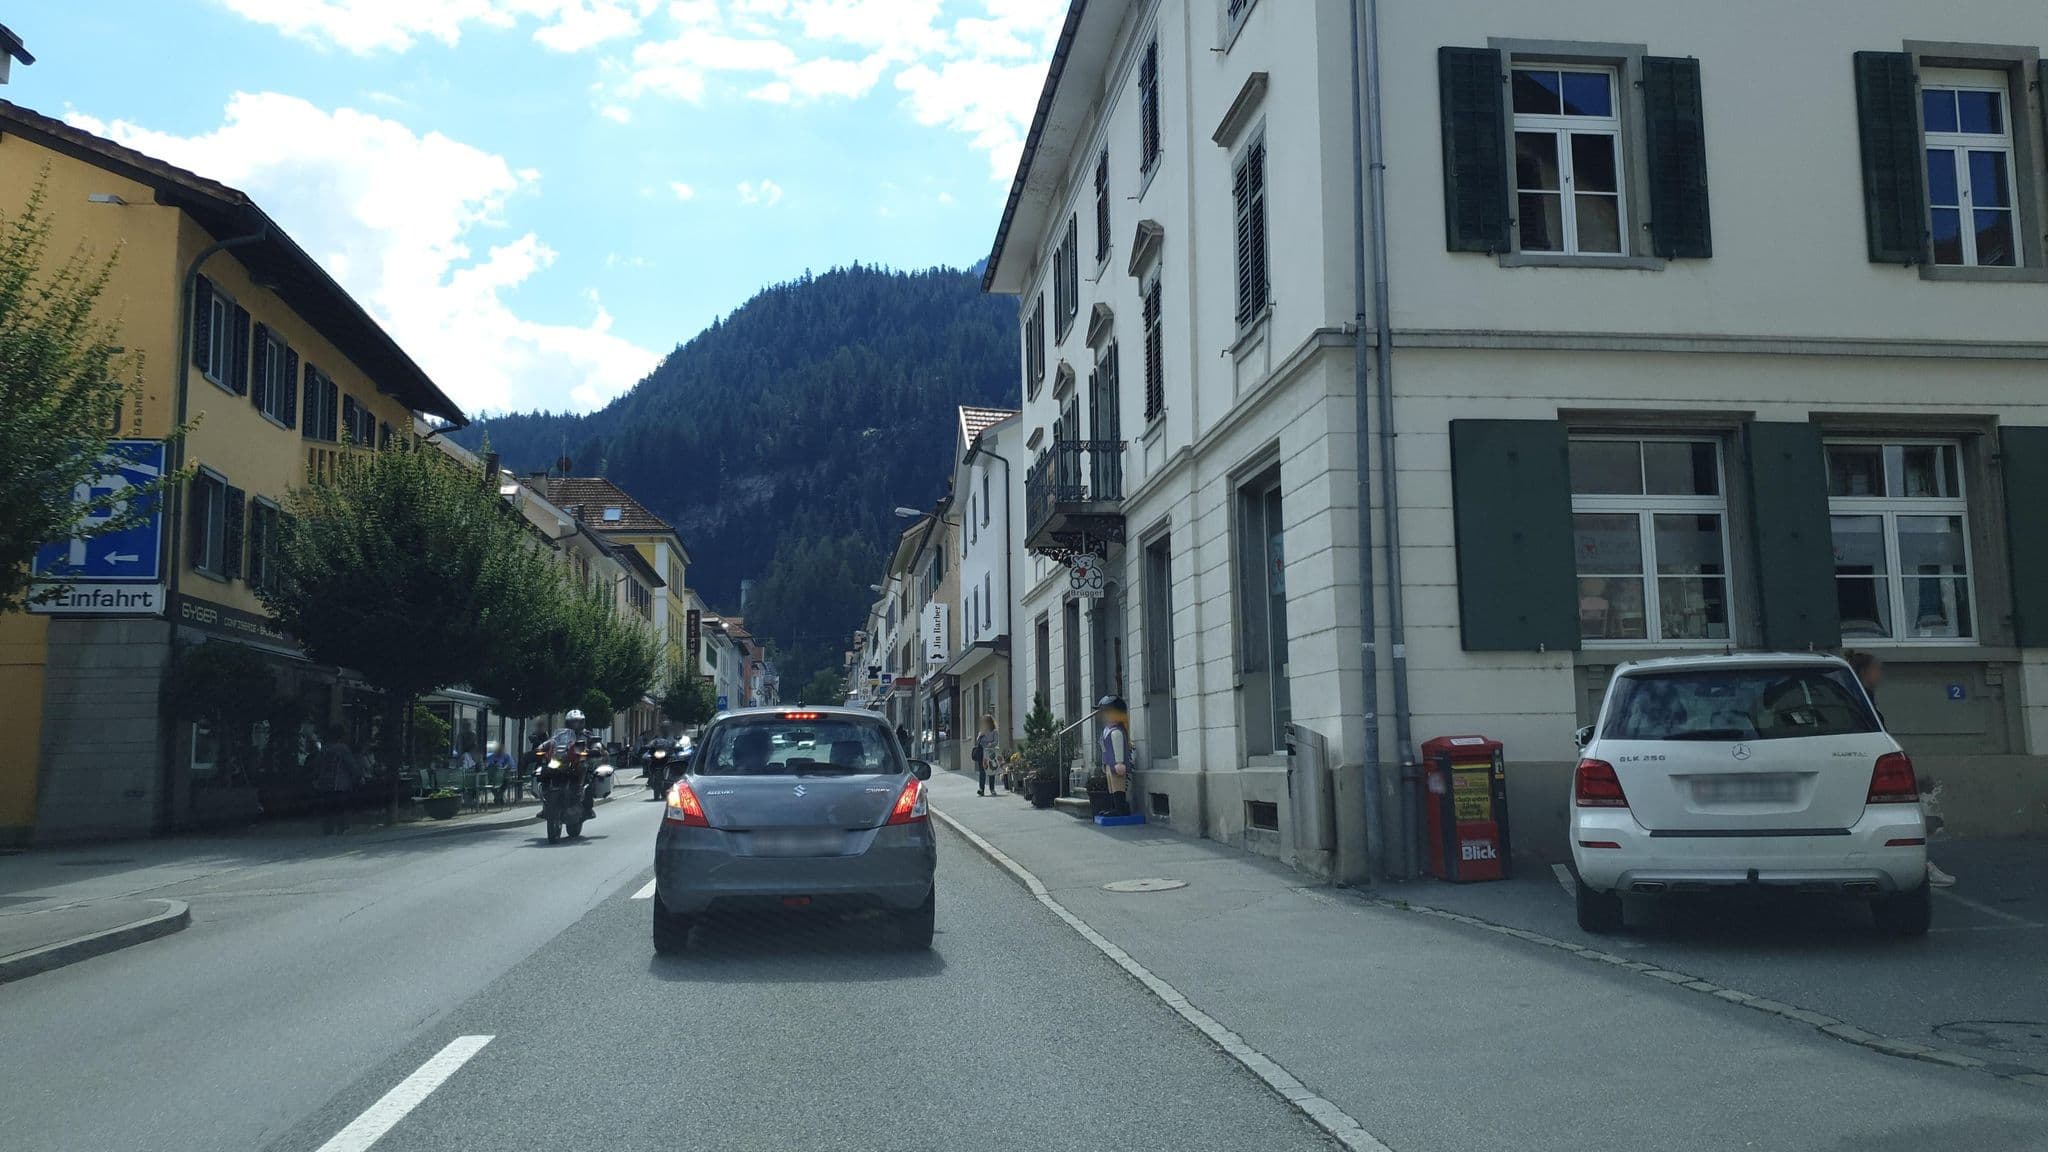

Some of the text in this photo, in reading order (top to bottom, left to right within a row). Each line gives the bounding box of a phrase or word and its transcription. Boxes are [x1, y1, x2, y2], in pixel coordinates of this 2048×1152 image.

[69, 474, 128, 566] P
[55, 589, 153, 607] Einfahrt
[933, 605, 941, 649] Jin Barber
[1952, 686, 1961, 698] 2
[1461, 845, 1497, 861] Blick
